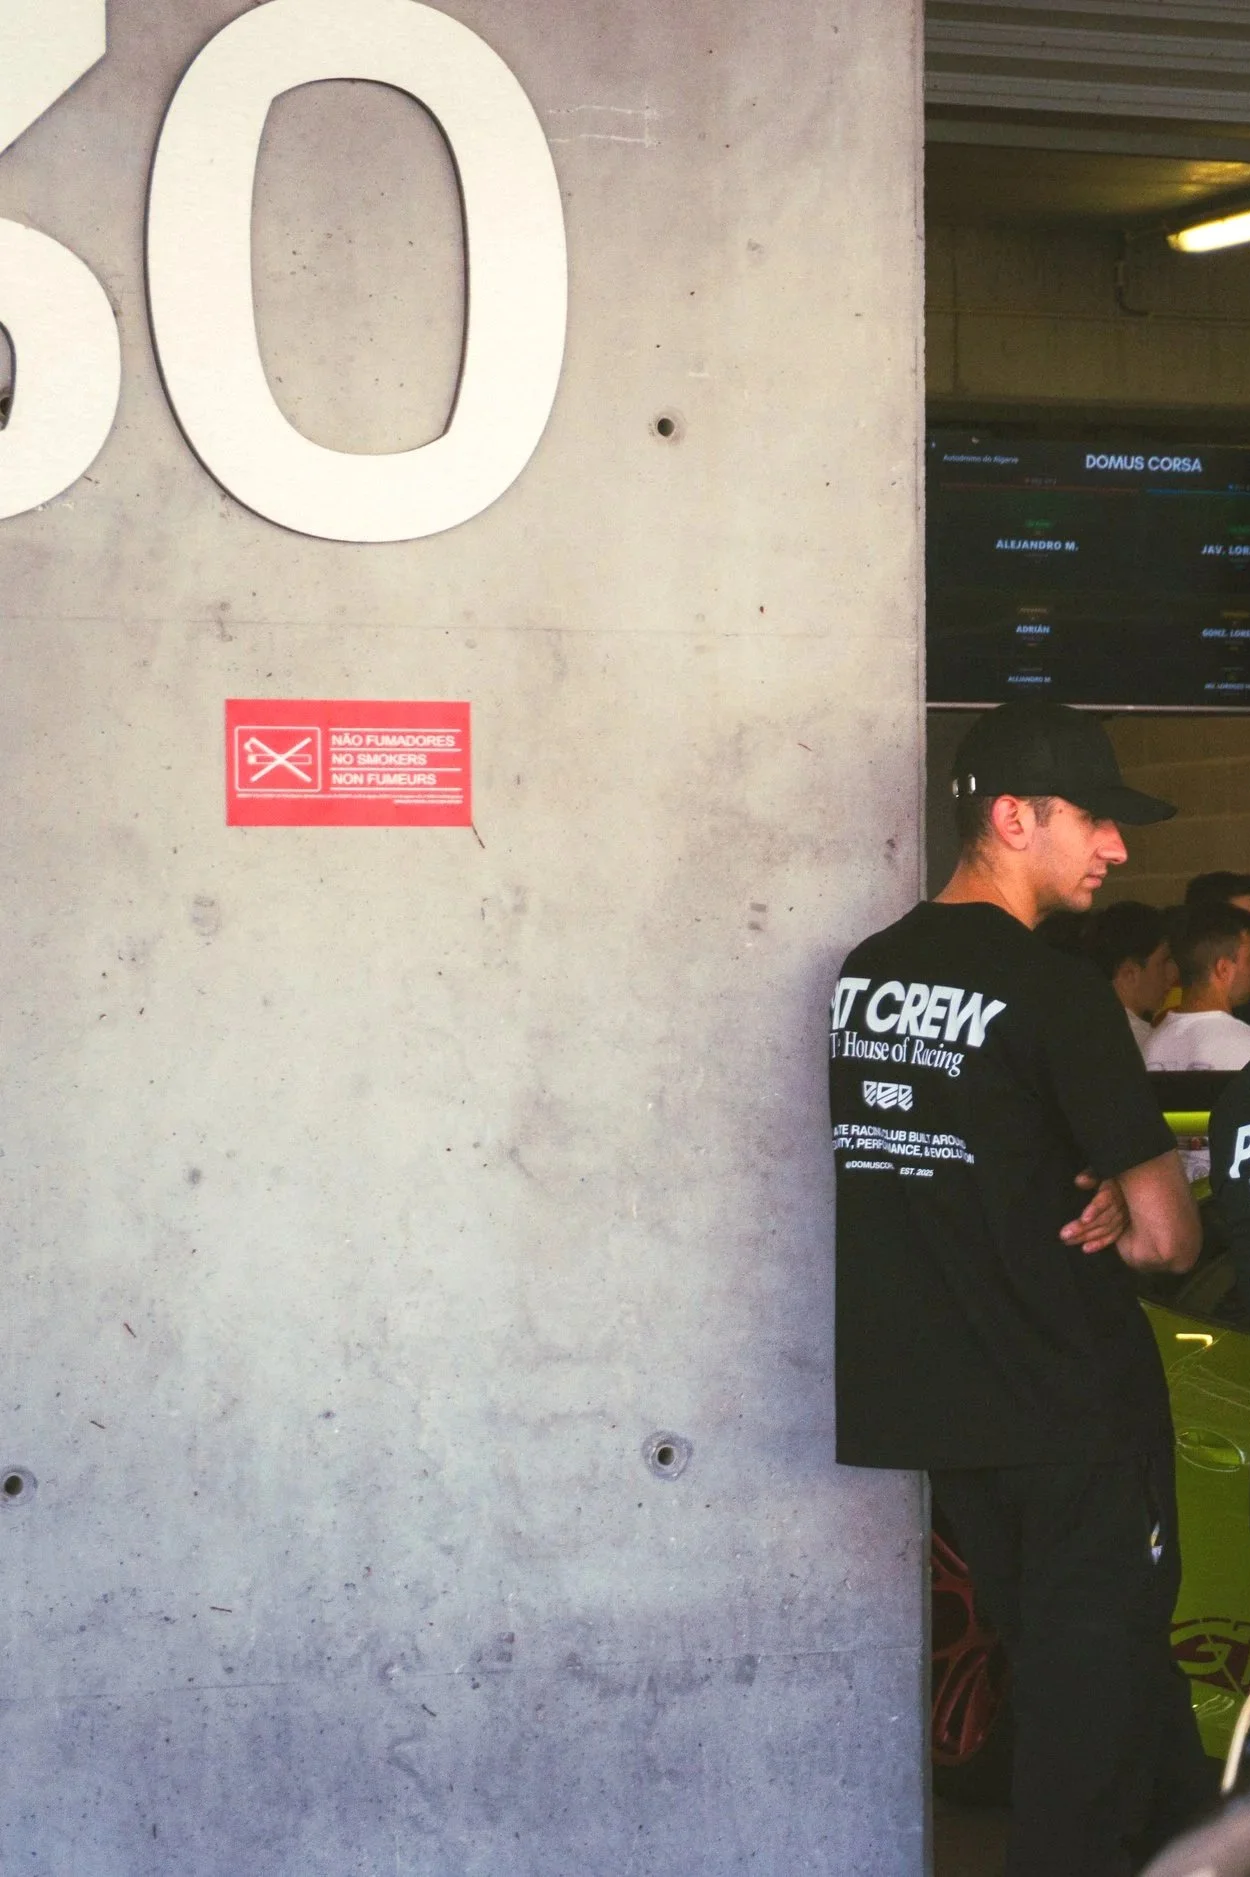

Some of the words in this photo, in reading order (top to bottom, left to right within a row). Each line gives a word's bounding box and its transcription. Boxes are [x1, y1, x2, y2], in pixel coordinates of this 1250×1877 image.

[1085, 454, 1144, 471] DOMUS
[1147, 455, 1203, 472] CORSA
[995, 538, 1062, 550] ALEJANDRO
[1064, 540, 1079, 551] M.
[1201, 544, 1226, 556] JAV.
[1016, 624, 1050, 634] ADRIÁN
[331, 733, 363, 748] NÃO
[366, 735, 455, 748] FUMADORES
[331, 753, 354, 766] NO
[357, 753, 427, 766] SMOKERS
[332, 773, 363, 785] NON
[367, 773, 436, 785] FUMEURS
[865, 980, 1007, 1047] CREW
[842, 1031, 889, 1061] House
[892, 1037, 909, 1062] of
[911, 1038, 965, 1077] Racing
[900, 1167, 915, 1177] EST.
[916, 1167, 934, 1178] 2025
